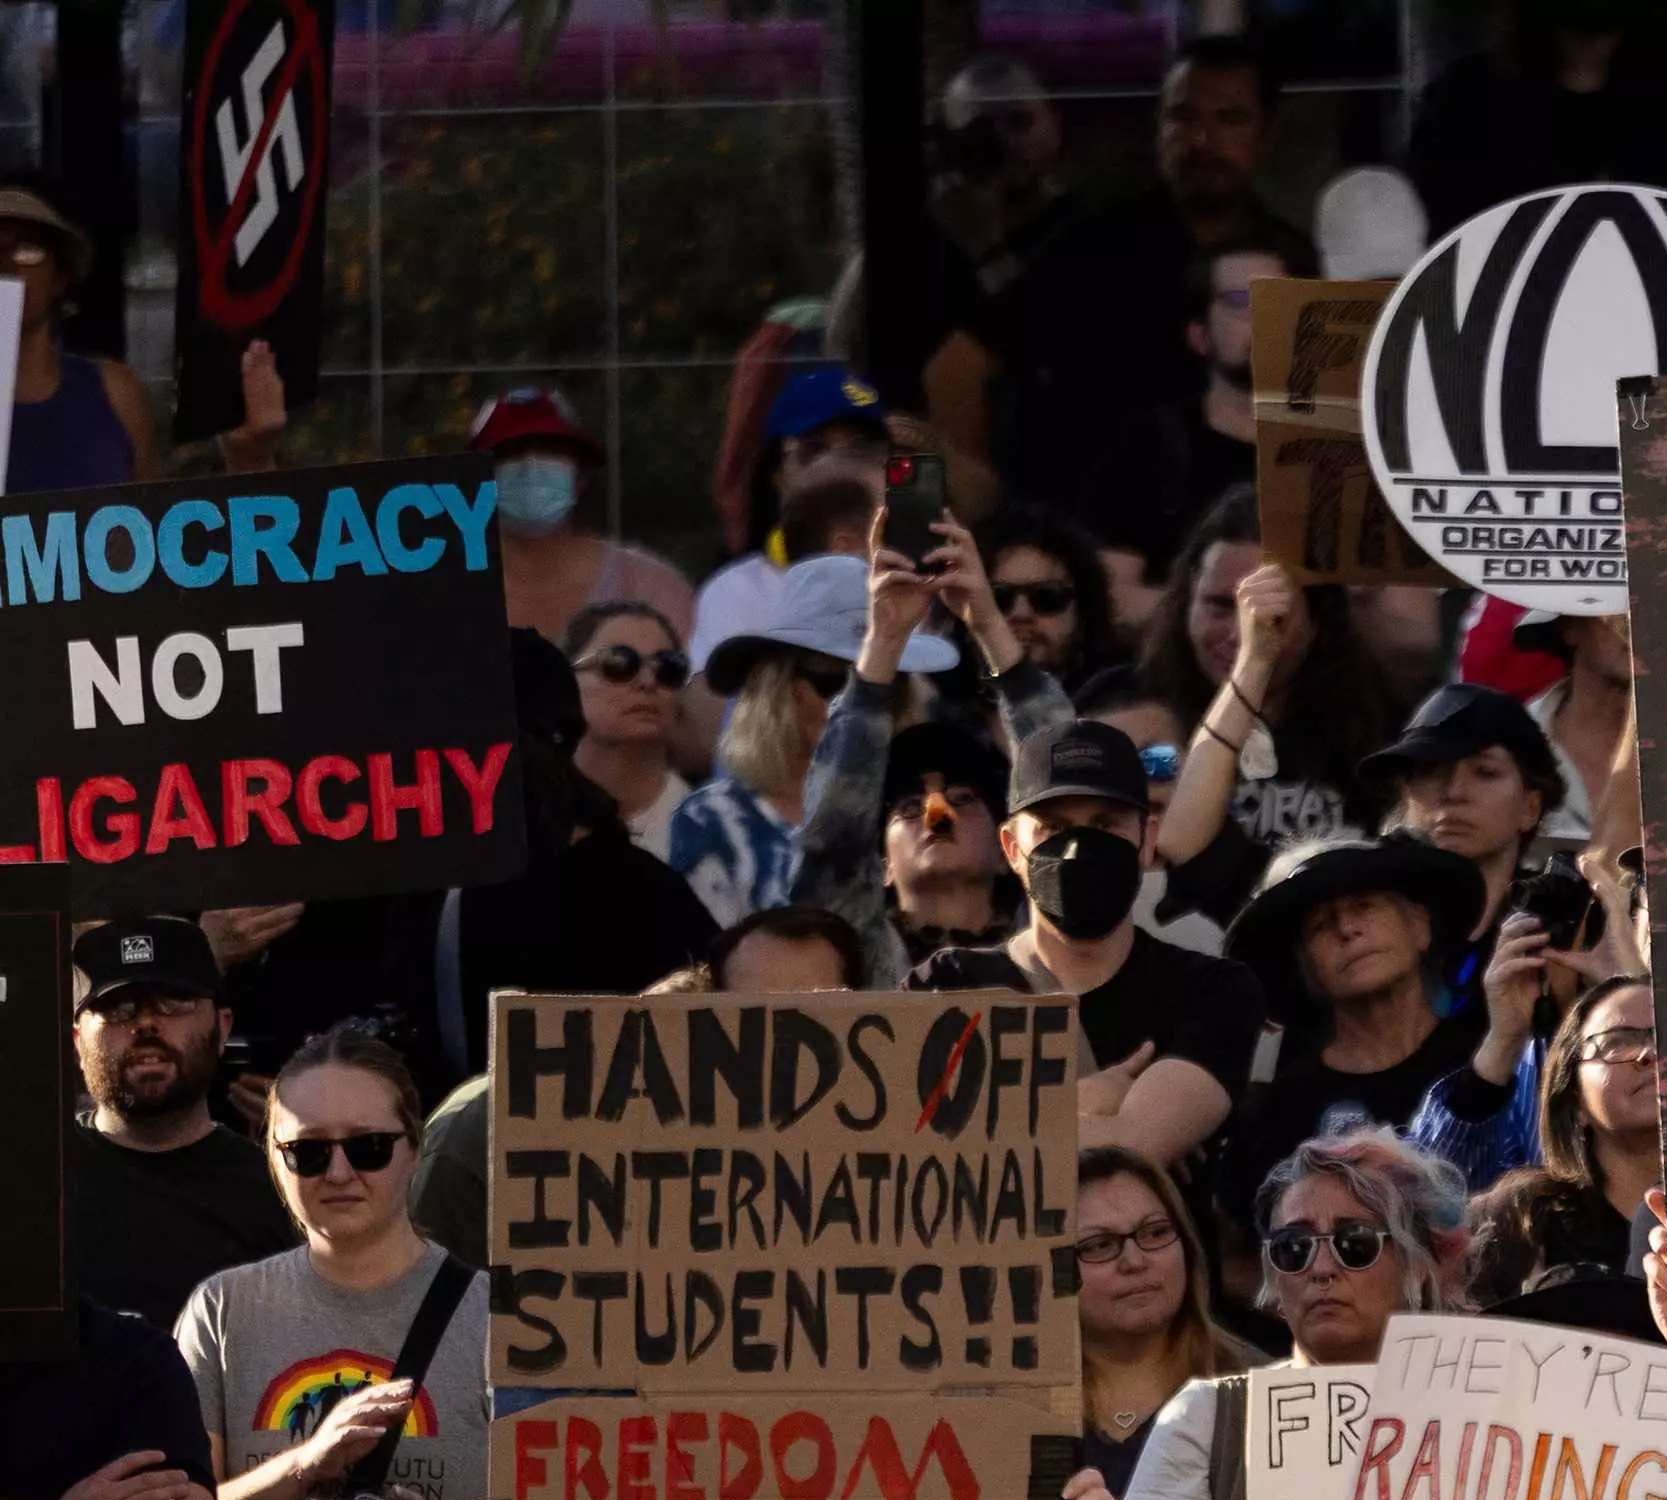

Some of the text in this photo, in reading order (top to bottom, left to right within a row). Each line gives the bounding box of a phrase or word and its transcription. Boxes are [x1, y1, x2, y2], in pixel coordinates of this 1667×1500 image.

[0, 480, 498, 606] MOCRACY
[1411, 488, 1624, 516] NATIO
[1441, 526, 1626, 550] ORGANIZ
[1483, 558, 1628, 579] FOR WO
[67, 622, 305, 730] NOT
[506, 1004, 1076, 1142] HANDS OFF
[505, 1146, 1069, 1253] INTERNATIONAL
[506, 1263, 1044, 1374] STUDENTS!!
[394, 1458, 446, 1480] UTU
[1267, 1382, 1371, 1468] FR
